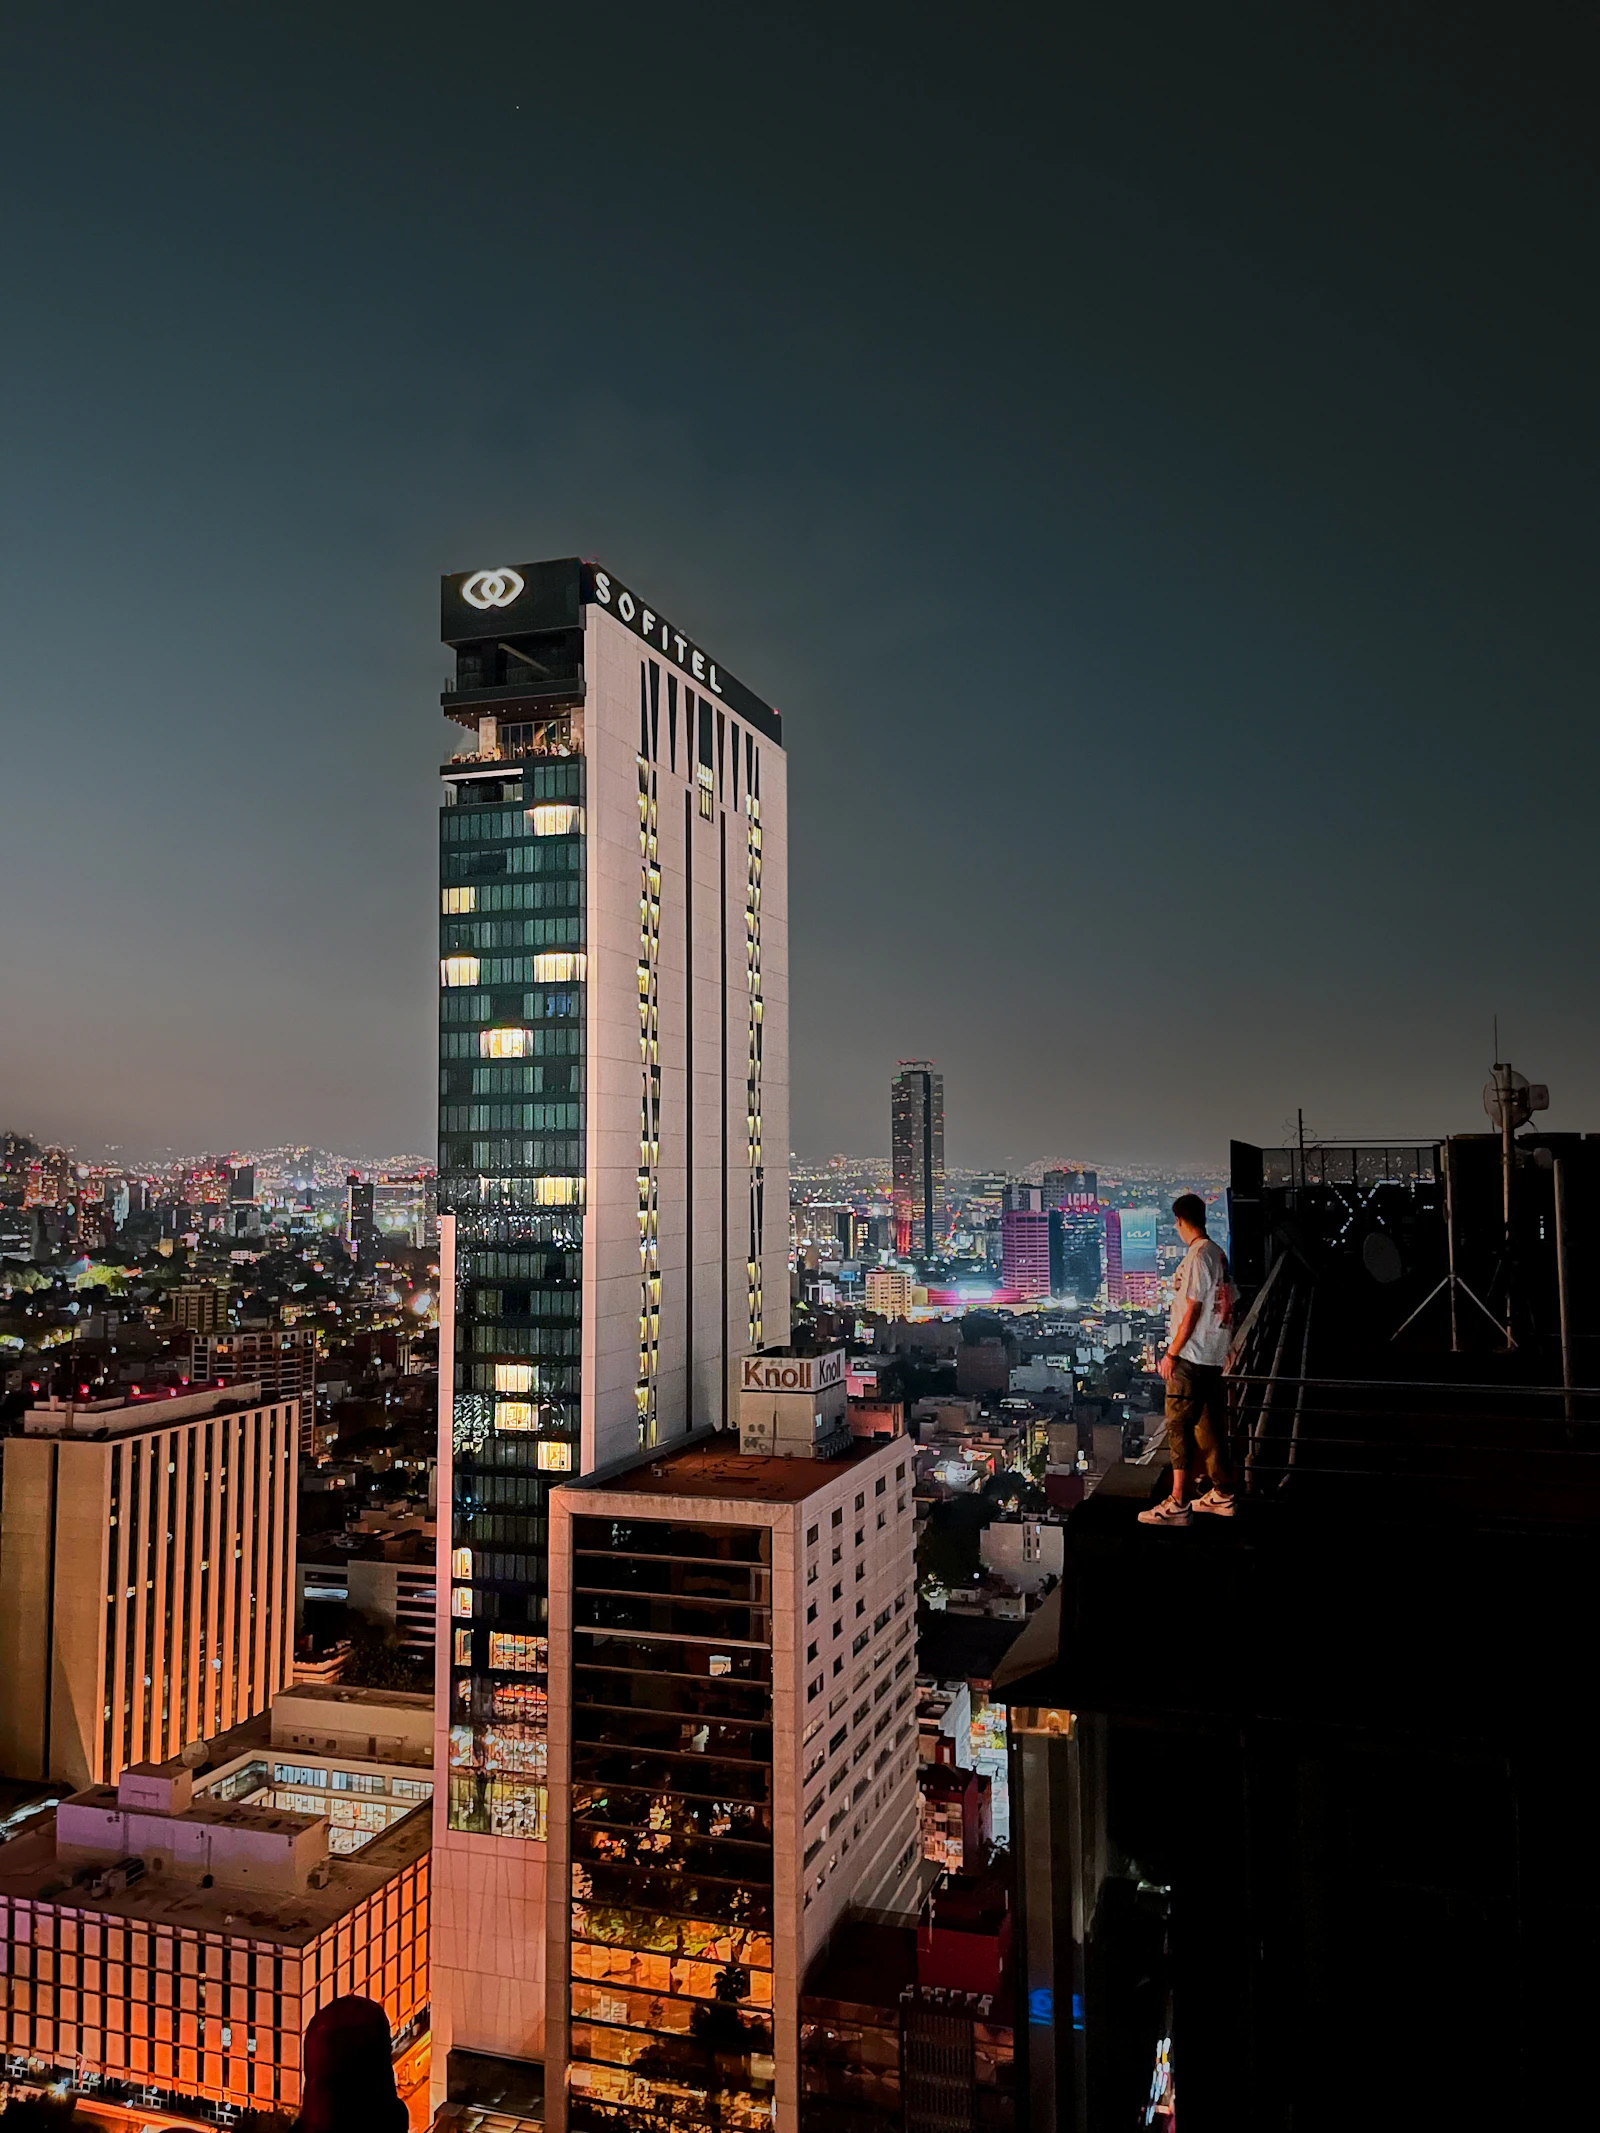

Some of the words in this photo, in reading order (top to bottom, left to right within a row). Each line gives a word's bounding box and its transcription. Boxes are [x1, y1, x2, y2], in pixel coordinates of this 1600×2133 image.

[595, 572, 722, 694] SOFITEL
[744, 1361, 812, 1388] Knoll
[819, 1353, 841, 1385] Knoll
